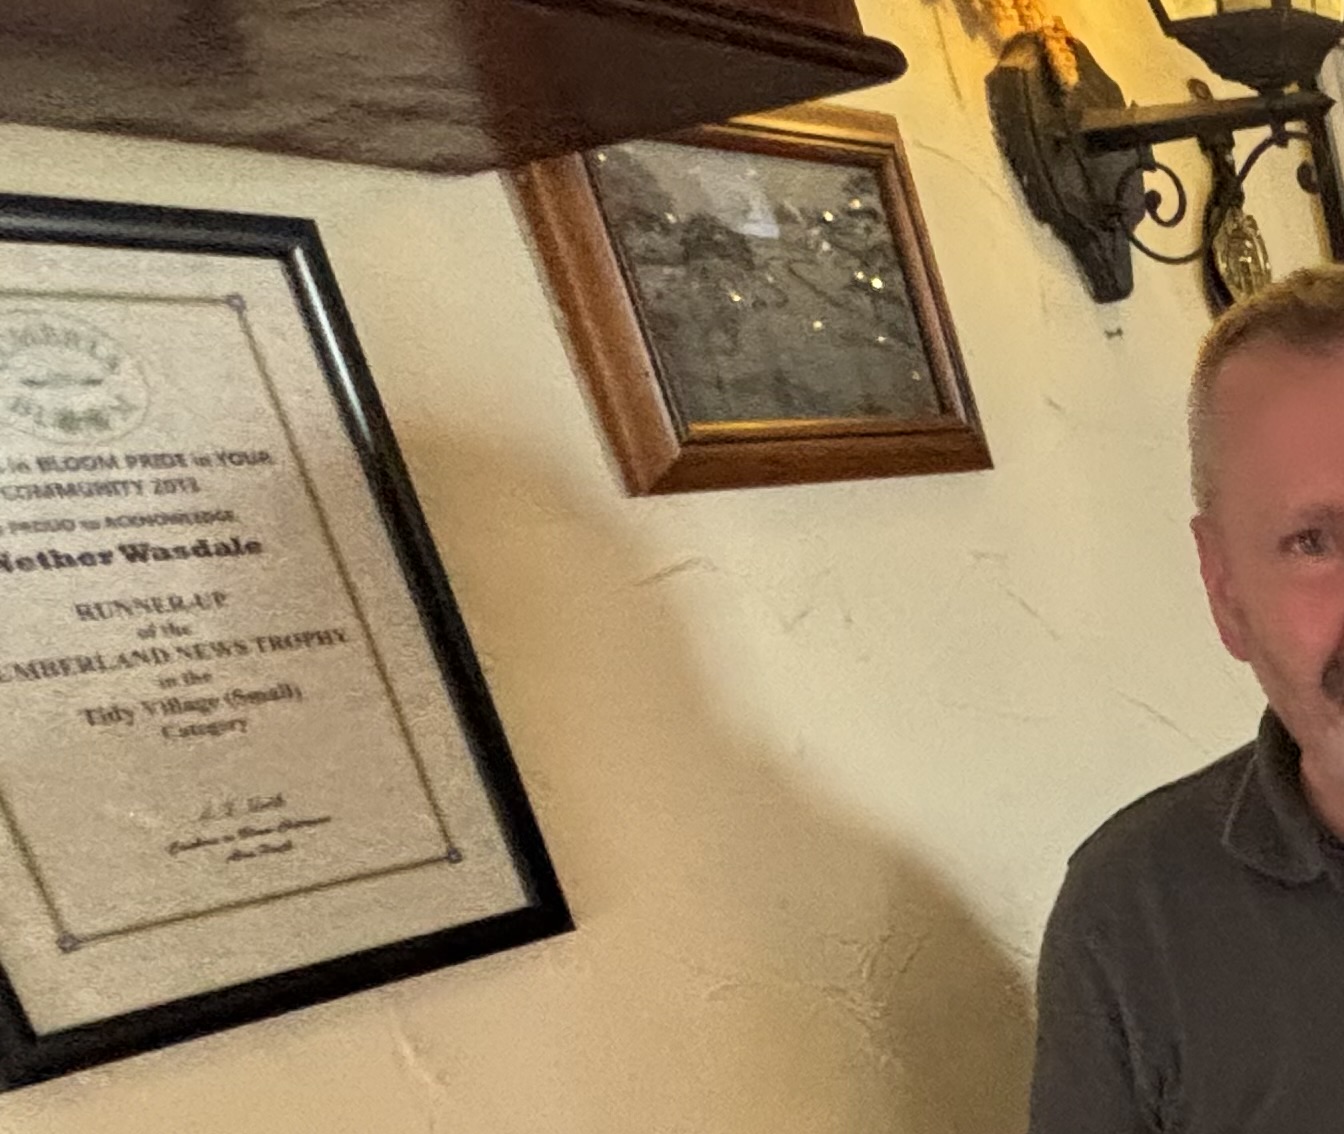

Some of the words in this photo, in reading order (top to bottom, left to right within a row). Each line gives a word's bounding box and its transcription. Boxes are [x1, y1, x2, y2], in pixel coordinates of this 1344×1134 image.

[36, 454, 120, 473] BLOOM
[125, 452, 190, 469] PRIDE
[215, 450, 272, 467] YOUR
[118, 536, 263, 563] Wasdale
[74, 589, 228, 621] RUNNER-UP
[160, 621, 193, 638] the
[0, 645, 171, 683] UMBERLAND
[174, 639, 251, 663] NEWS
[253, 628, 349, 653] TROPHY
[182, 669, 213, 685] the
[81, 704, 135, 726] Tidy
[141, 697, 220, 716] Village
[223, 683, 303, 708] (Small)
[161, 718, 248, 739] Category
